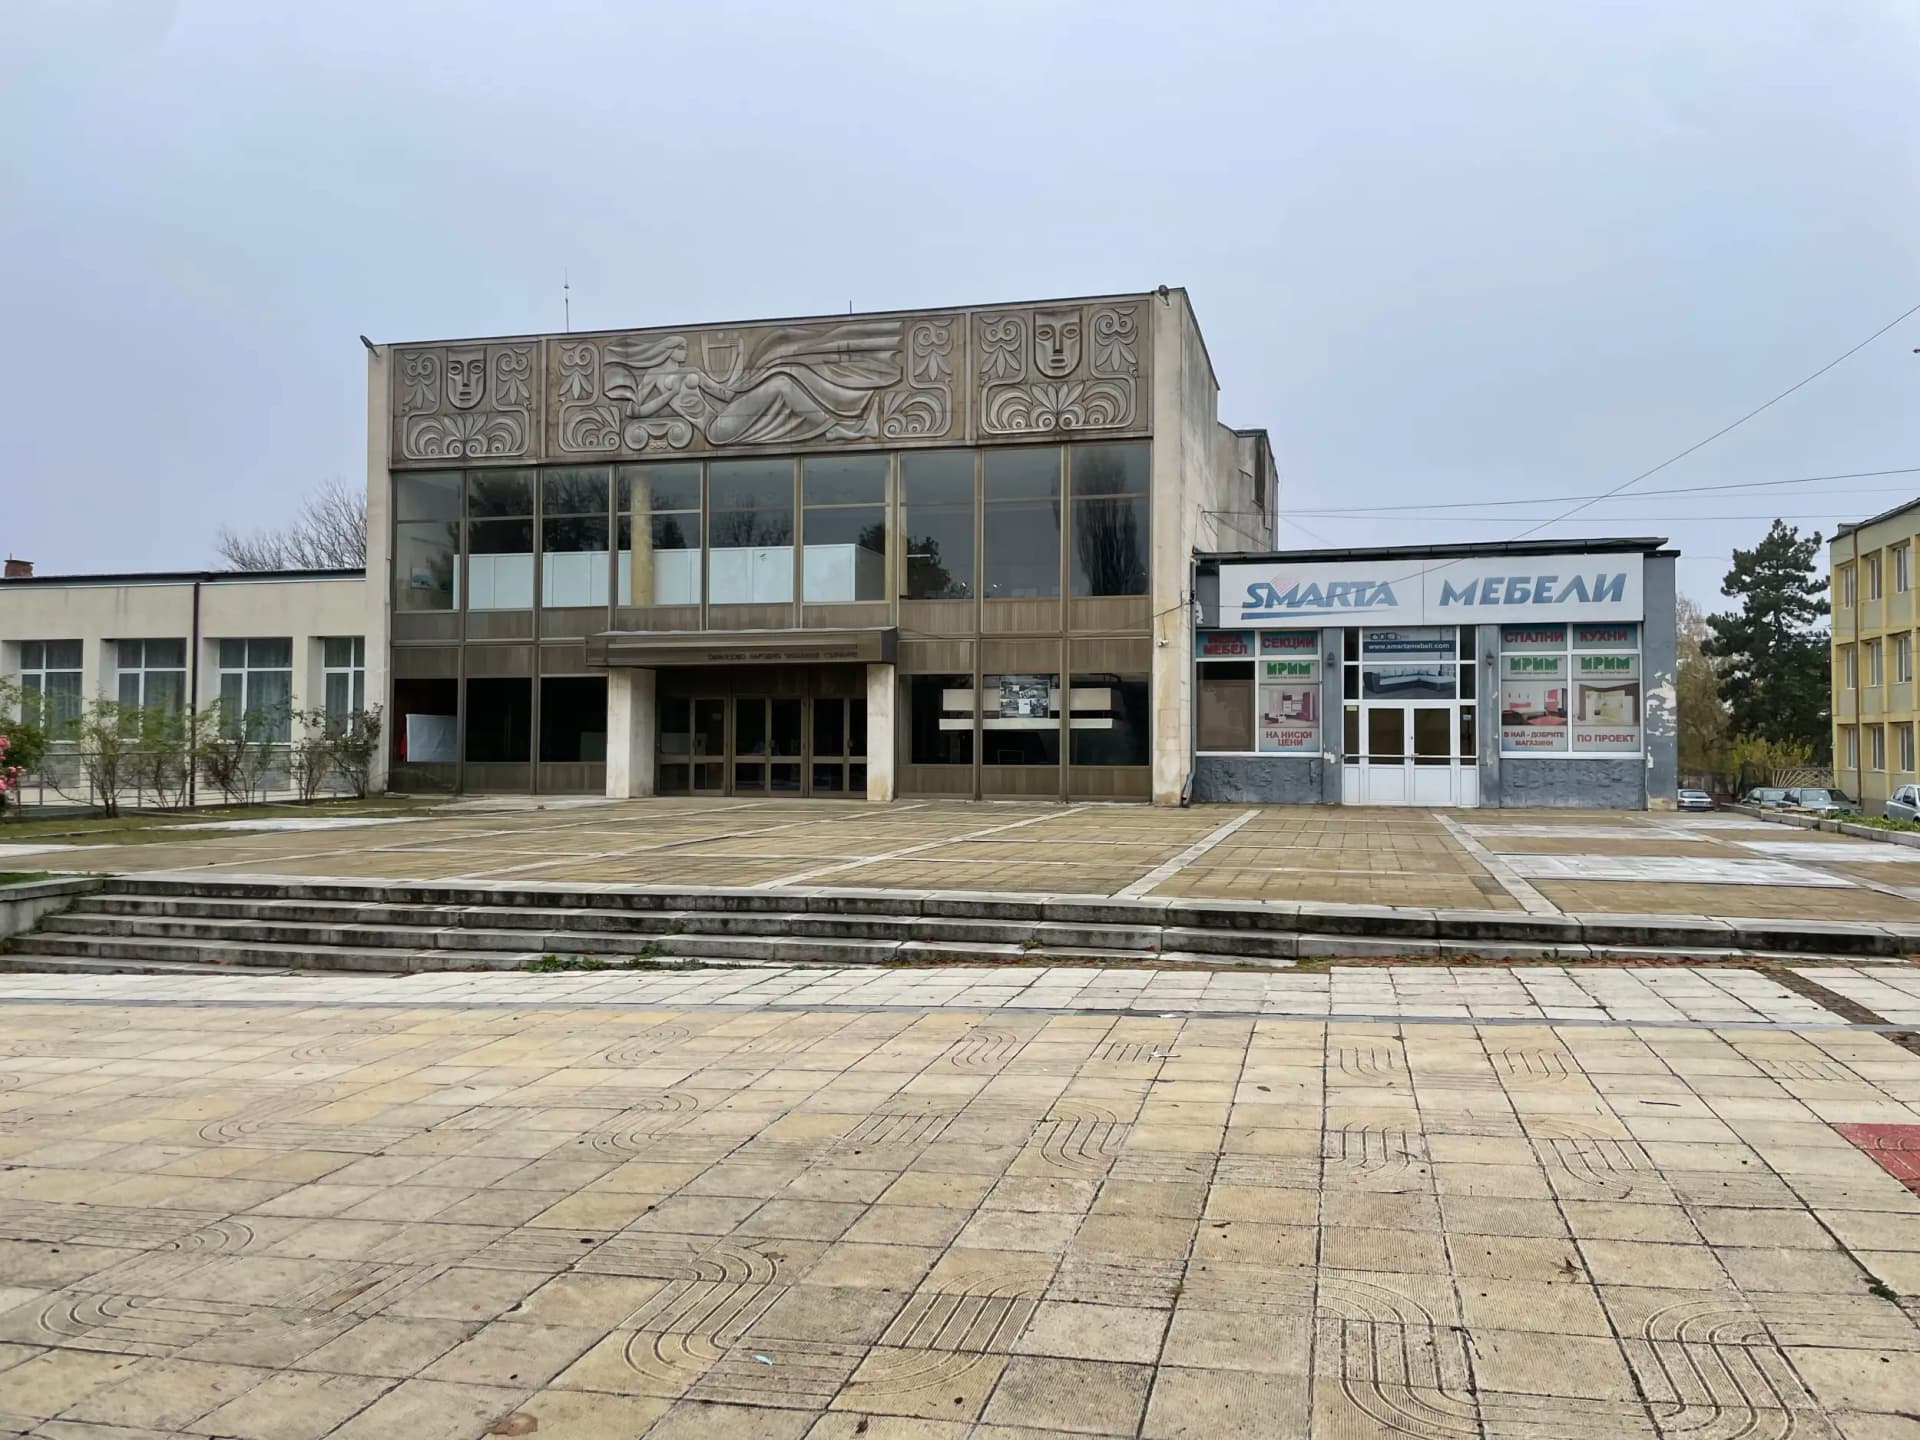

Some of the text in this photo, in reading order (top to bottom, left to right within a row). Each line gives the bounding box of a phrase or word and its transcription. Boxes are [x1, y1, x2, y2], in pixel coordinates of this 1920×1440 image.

[1242, 573, 1627, 609] SMARTA МЕБЕЛИ
[1504, 631, 1564, 643] СПАЛНИ
[1580, 630, 1628, 642] КУХНИ
[1263, 637, 1314, 649] СЕКЦИИ
[1267, 662, 1311, 675] ИРИМ
[1510, 657, 1558, 670] ИРИМ
[1581, 656, 1630, 670] ИРИМ
[1266, 731, 1279, 739] НА
[1577, 734, 1636, 743] ПО ПРОЕКТ
[1277, 739, 1303, 747] ЦЕНИ
